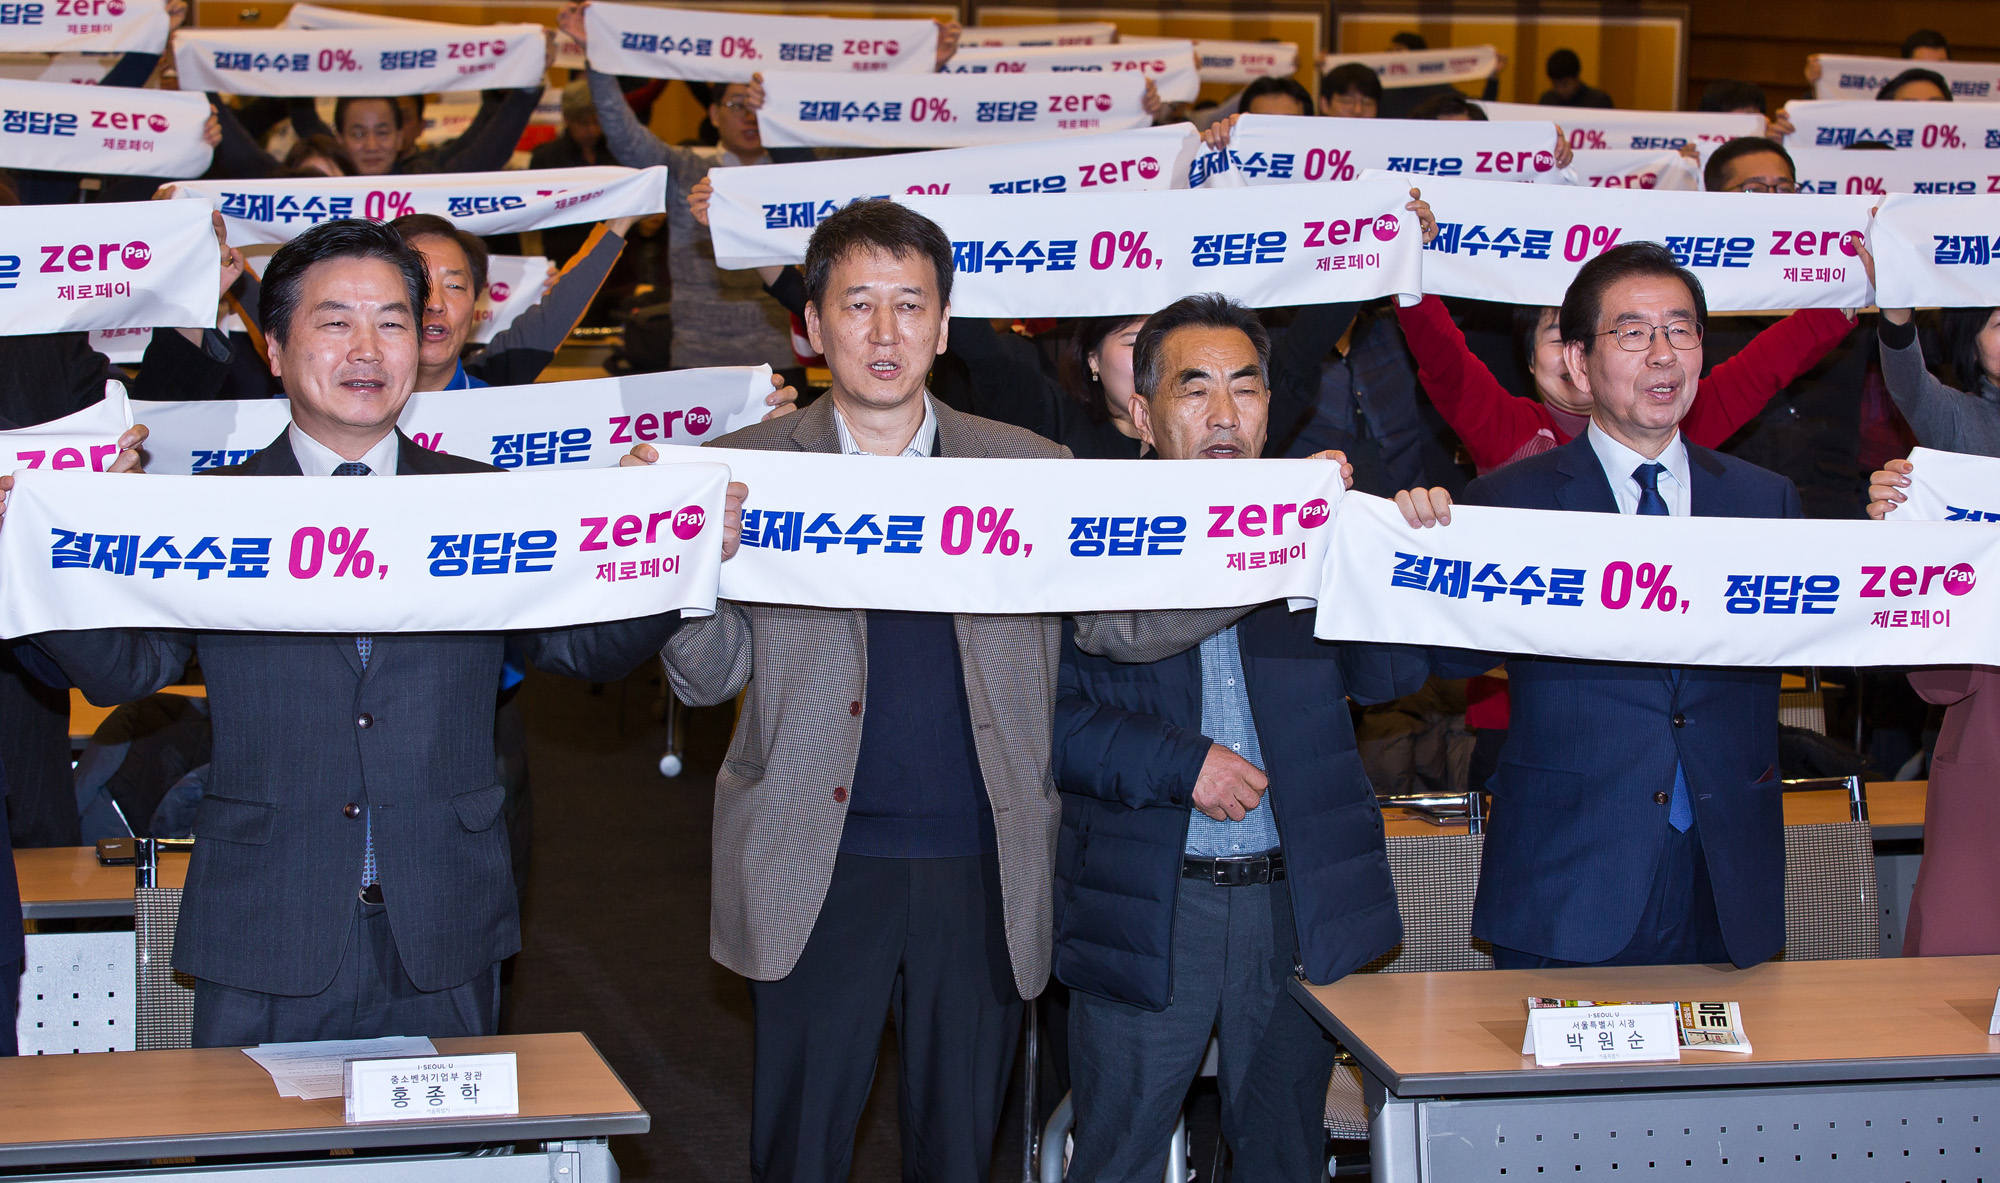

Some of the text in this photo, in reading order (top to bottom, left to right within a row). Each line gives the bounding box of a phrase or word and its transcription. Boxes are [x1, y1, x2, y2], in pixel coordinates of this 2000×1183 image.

[68, 25, 112, 34] 제로페이
[621, 32, 712, 55] 결제수수료
[779, 43, 833, 61] 정답은
[214, 51, 309, 71] 결제수수료
[380, 49, 437, 70] 정답은
[800, 101, 901, 121] 결제수수료
[976, 101, 1037, 121] 정답은
[1049, 94, 1111, 112] zero
[2, 110, 77, 136] 정답은
[92, 111, 168, 133] zero
[1058, 120, 1099, 129] 제로페이
[104, 139, 153, 152] 제로페이
[1079, 157, 1160, 187] zero Pay
[1476, 150, 1558, 173] zero
[1304, 214, 1401, 247] zero Pay
[40, 241, 151, 272] zero Pay
[1090, 231, 1162, 270] 0%,
[1192, 231, 1287, 266] 정답은
[1316, 253, 1379, 271] 제로페이
[1666, 236, 1755, 267] 정답은
[1784, 268, 1845, 282] 제로페이
[58, 282, 130, 300] 제로페이
[610, 407, 712, 444] zero Pay
[490, 428, 591, 468] 정답은
[580, 506, 706, 551] zero Pay
[1208, 499, 1330, 537] zero Pay
[941, 506, 1032, 557] 0%,
[1069, 516, 1186, 556] 정답은
[51, 527, 556, 580] 결제수수료 0%, 정답은
[1227, 543, 1305, 570] 제로페이
[596, 556, 679, 582] 제로페이
[1860, 563, 1976, 597] zero Pay
[1392, 552, 1840, 614] 결제수수료 0%, 정답은
[1871, 609, 1949, 628] 제로페이
[1572, 1019, 1635, 1030] 서울특별시 시장
[391, 1071, 483, 1084] 중소벤처기업부 장관
